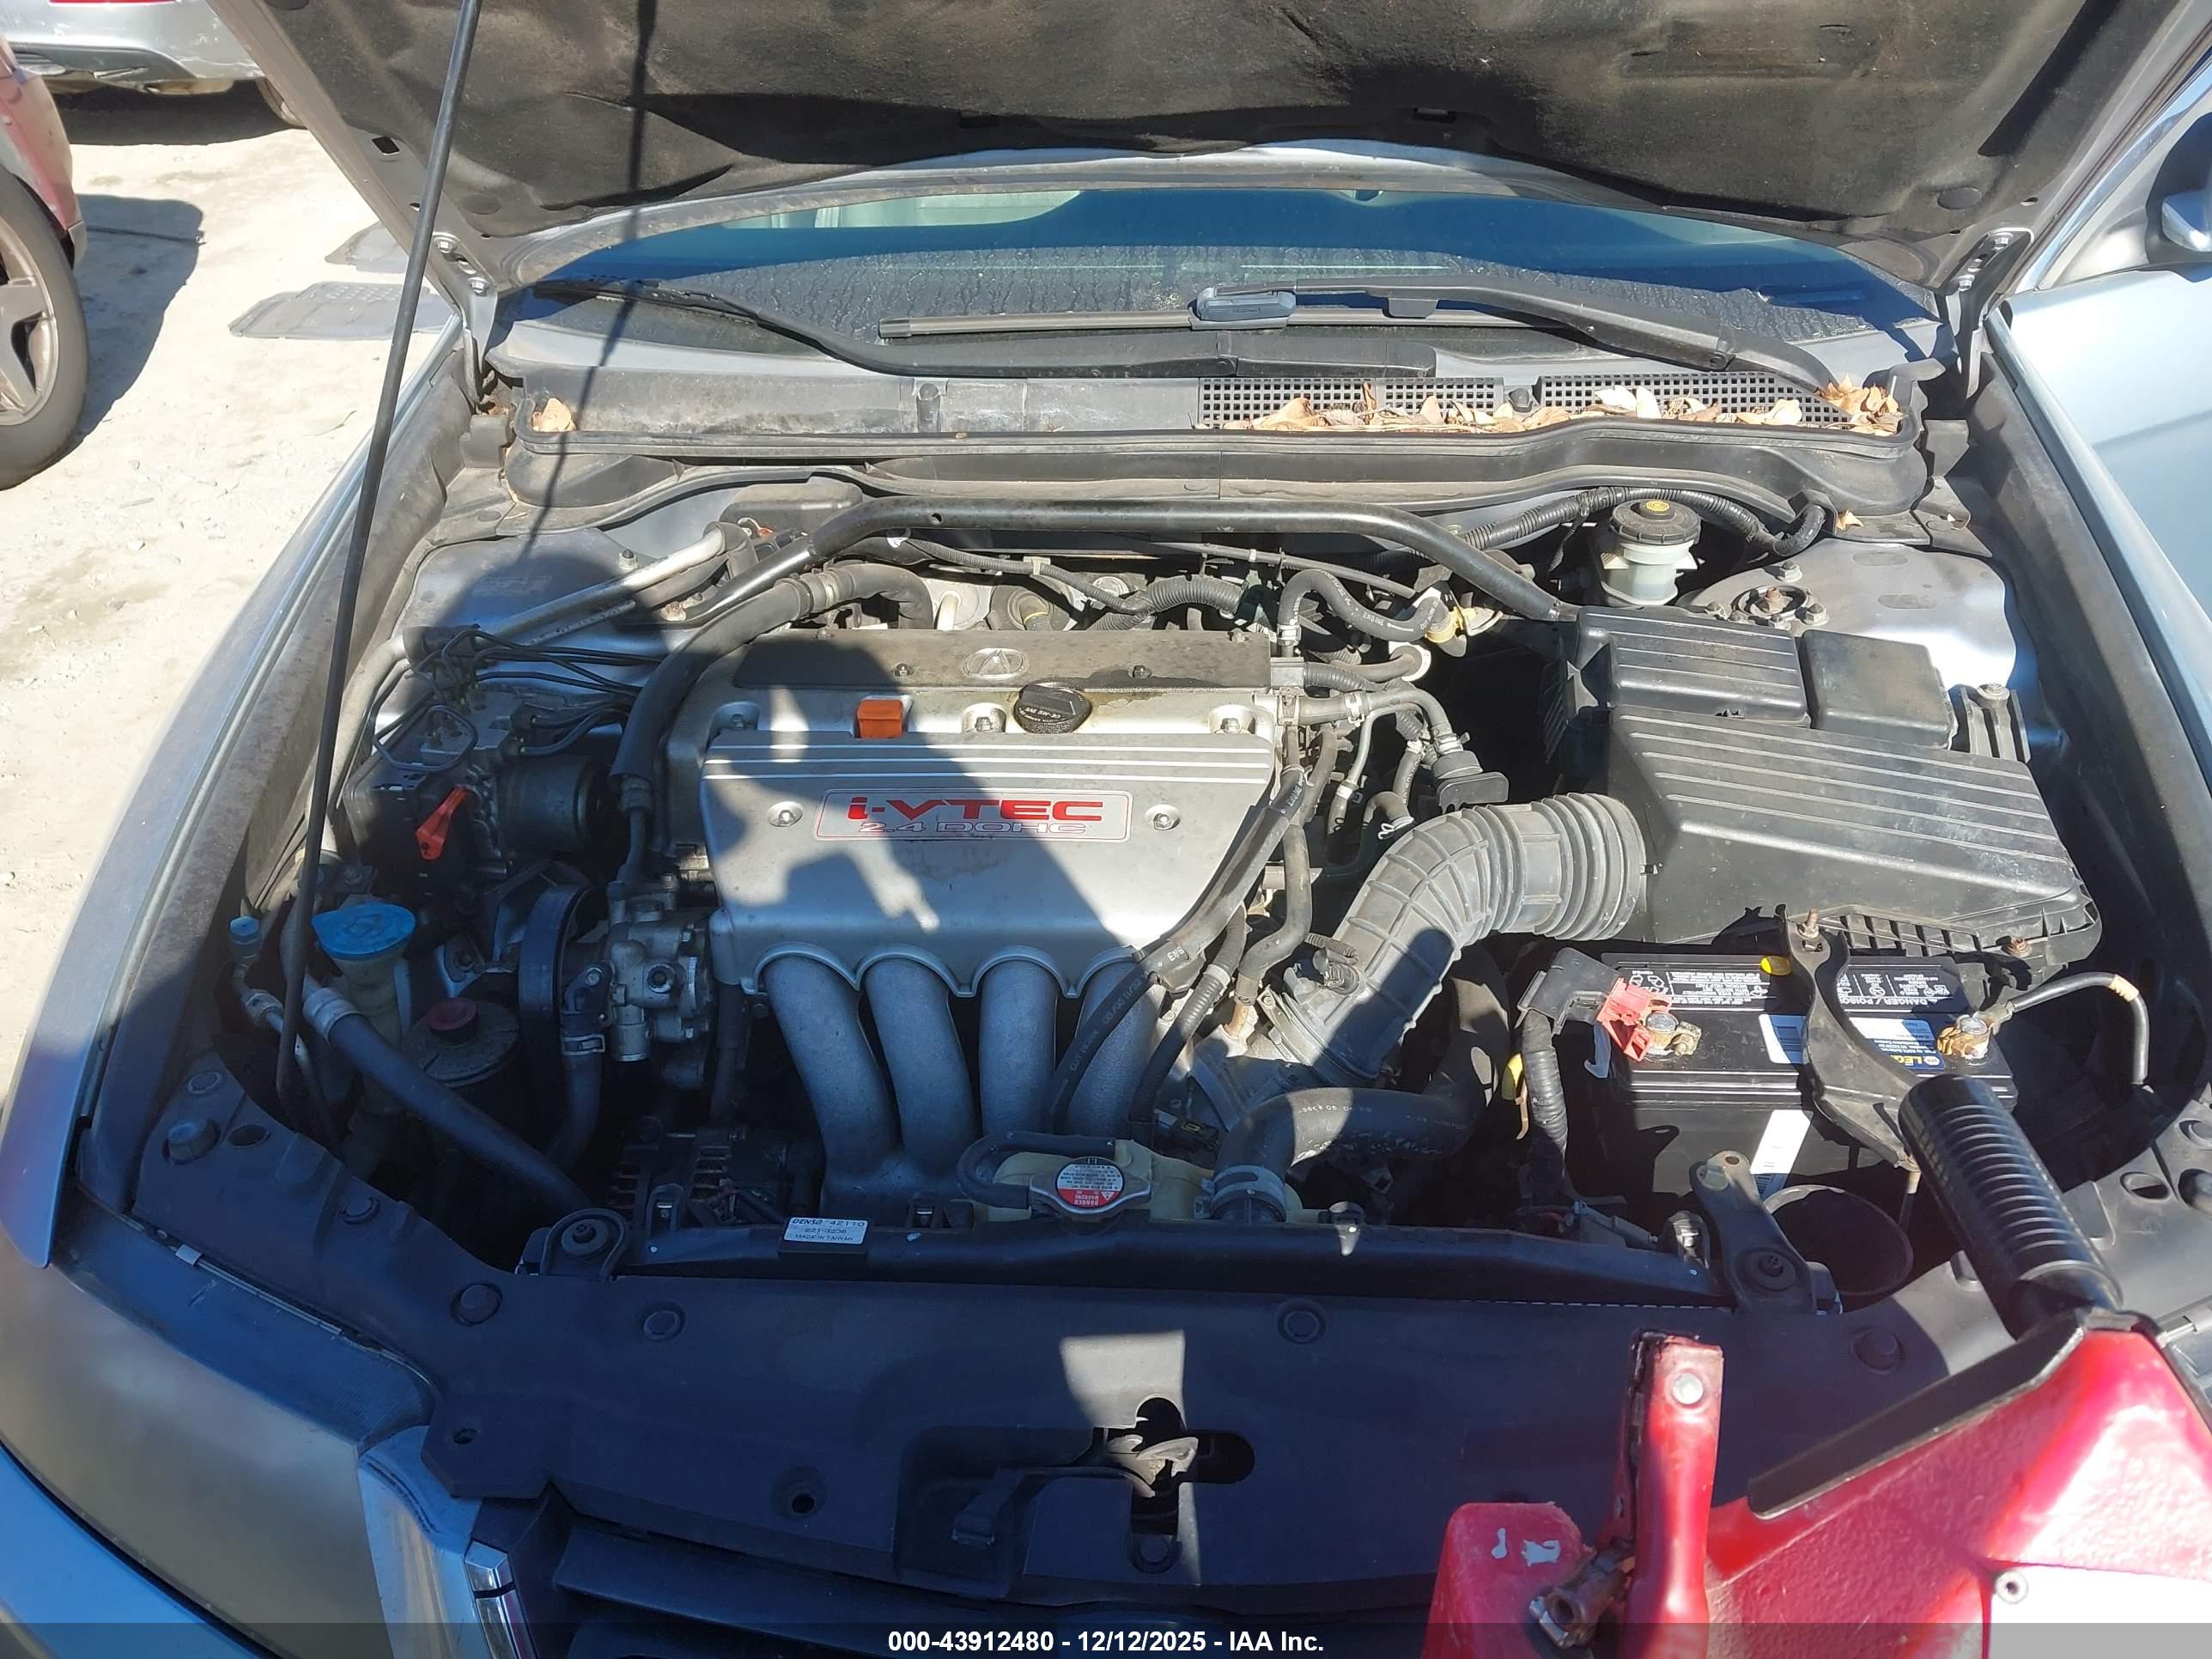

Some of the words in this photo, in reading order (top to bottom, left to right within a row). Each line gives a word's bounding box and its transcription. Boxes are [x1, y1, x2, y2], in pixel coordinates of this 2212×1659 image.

[847, 796, 1103, 821] i-VTEC
[859, 822, 927, 833] 2.4
[935, 822, 1086, 835] DOHC
